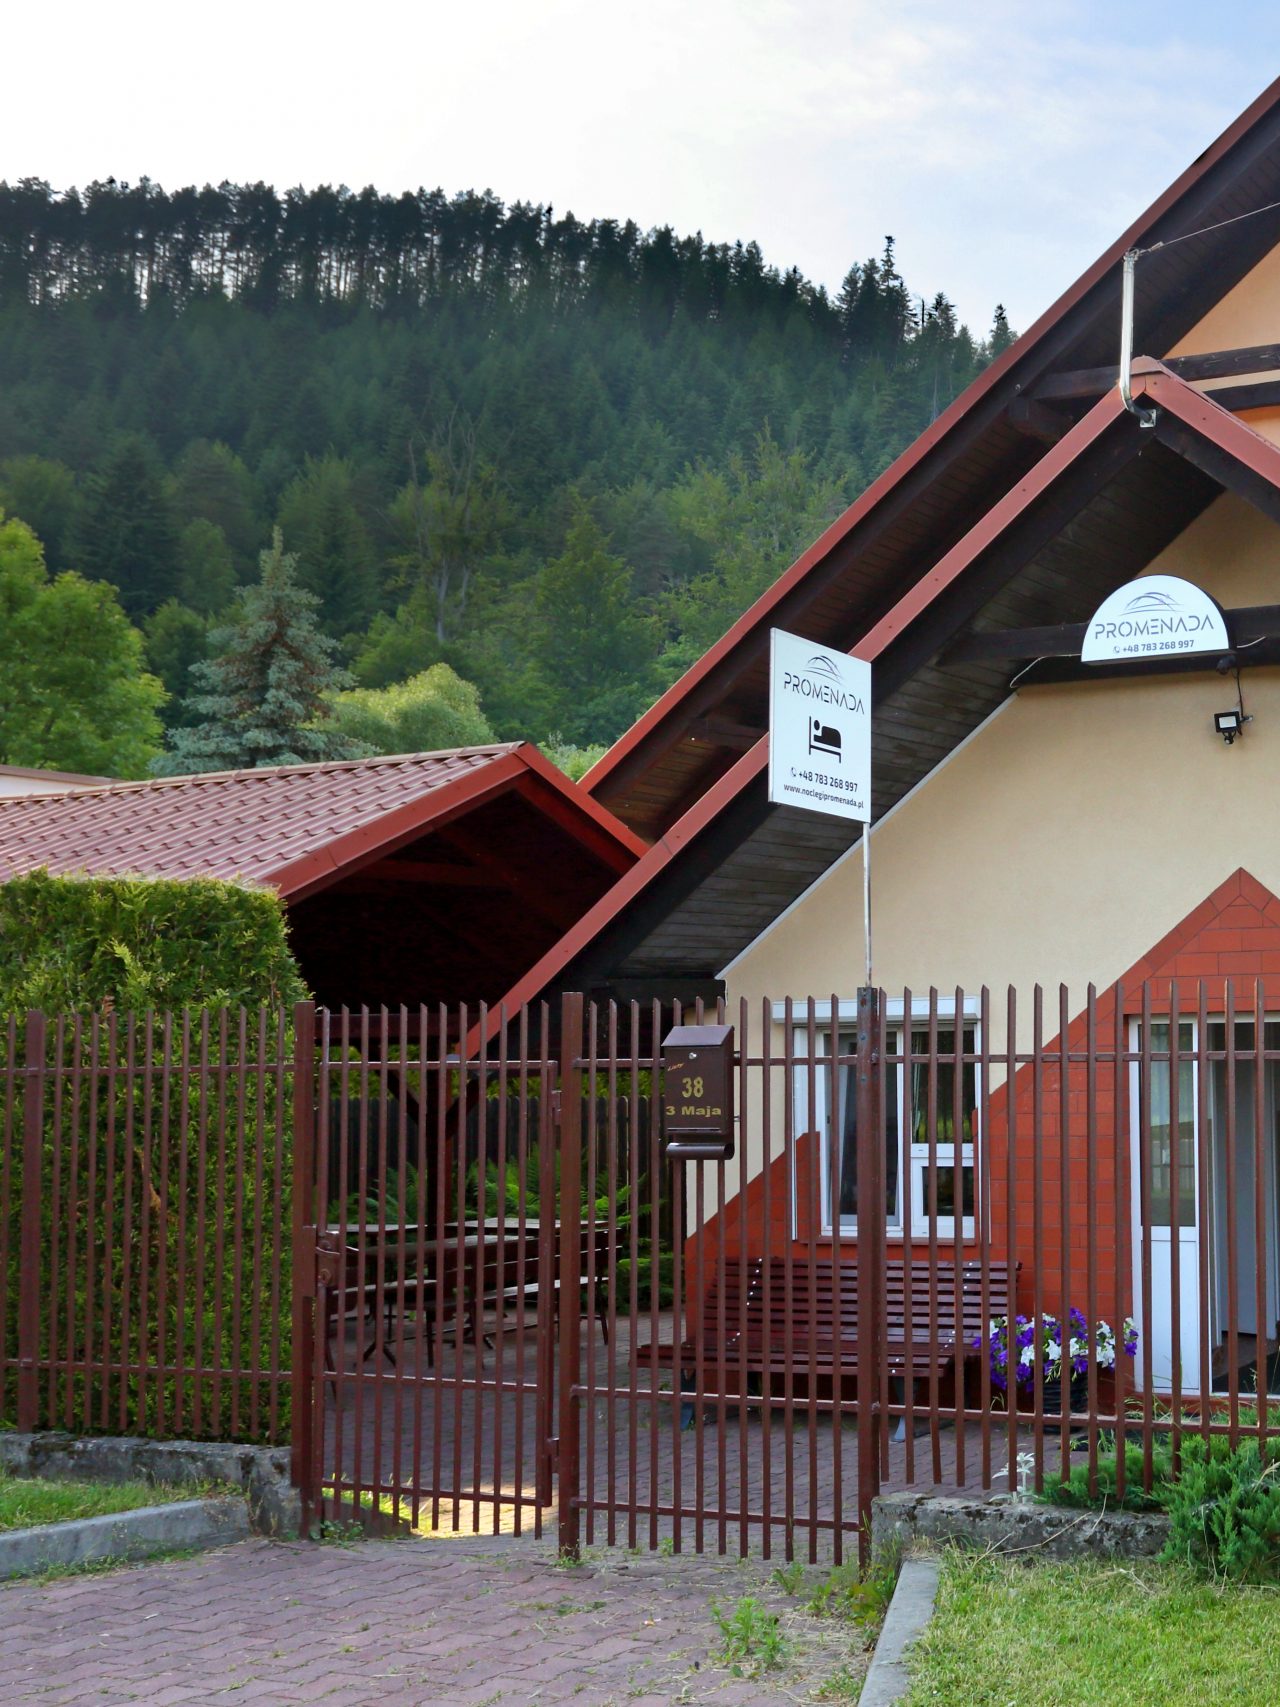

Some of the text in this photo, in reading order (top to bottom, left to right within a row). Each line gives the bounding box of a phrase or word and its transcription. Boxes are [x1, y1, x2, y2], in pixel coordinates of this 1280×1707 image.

[1095, 614, 1214, 640] PROMENADA
[1122, 639, 1194, 653] +48 783 268 997
[784, 672, 864, 714] PROMENADA
[799, 770, 858, 793] +48 783 268 997
[783, 783, 864, 809] www.noclegipromenada.pl
[682, 1077, 704, 1098] 38
[666, 1105, 721, 1118] 3 Maja
